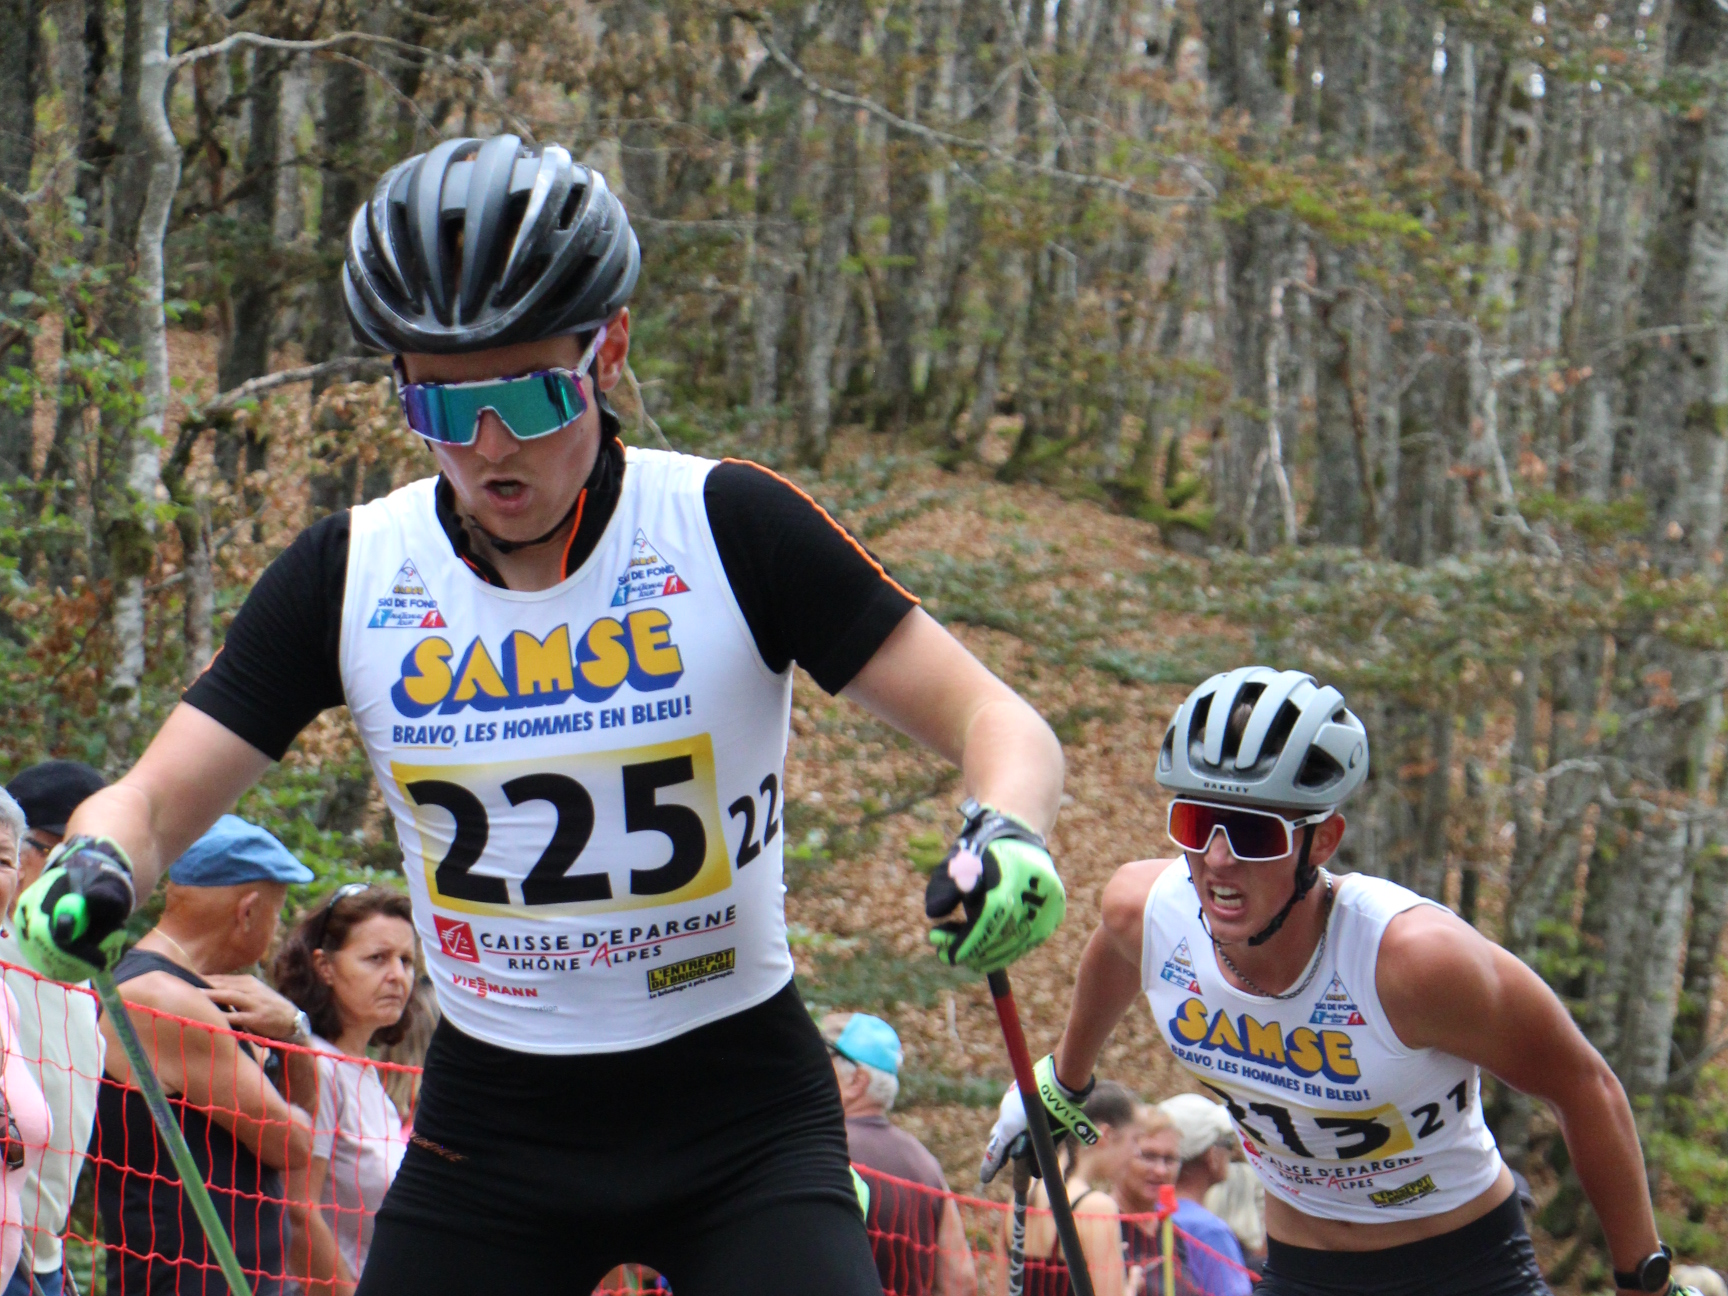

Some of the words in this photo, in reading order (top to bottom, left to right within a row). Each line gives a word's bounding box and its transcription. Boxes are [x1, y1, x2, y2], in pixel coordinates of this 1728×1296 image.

[646, 564, 676, 577] FOND
[394, 598, 408, 608] DE
[410, 599, 438, 609] FOND
[391, 608, 685, 718] SAMSE
[392, 724, 459, 747] BRAVO,
[464, 721, 498, 743] LES
[502, 710, 594, 741] HOMMES
[600, 707, 627, 729] EN
[1203, 782, 1250, 794] OAKLEY
[405, 754, 708, 906] 225
[728, 772, 780, 870] 22
[479, 931, 570, 951] CAISSE
[582, 904, 737, 949] D'EPARGNE
[508, 956, 581, 971] RHÔNE
[590, 942, 663, 968] ALPES
[452, 973, 538, 998] VIESSMANN
[1169, 998, 1362, 1084] SAMSE
[1171, 1045, 1215, 1071] BRAVO,
[1217, 1058, 1238, 1074] LES
[1242, 1065, 1300, 1091] HOMMES
[1303, 1082, 1323, 1098] EN
[1411, 1079, 1468, 1140] 21
[1327, 1175, 1374, 1191] ALPES
